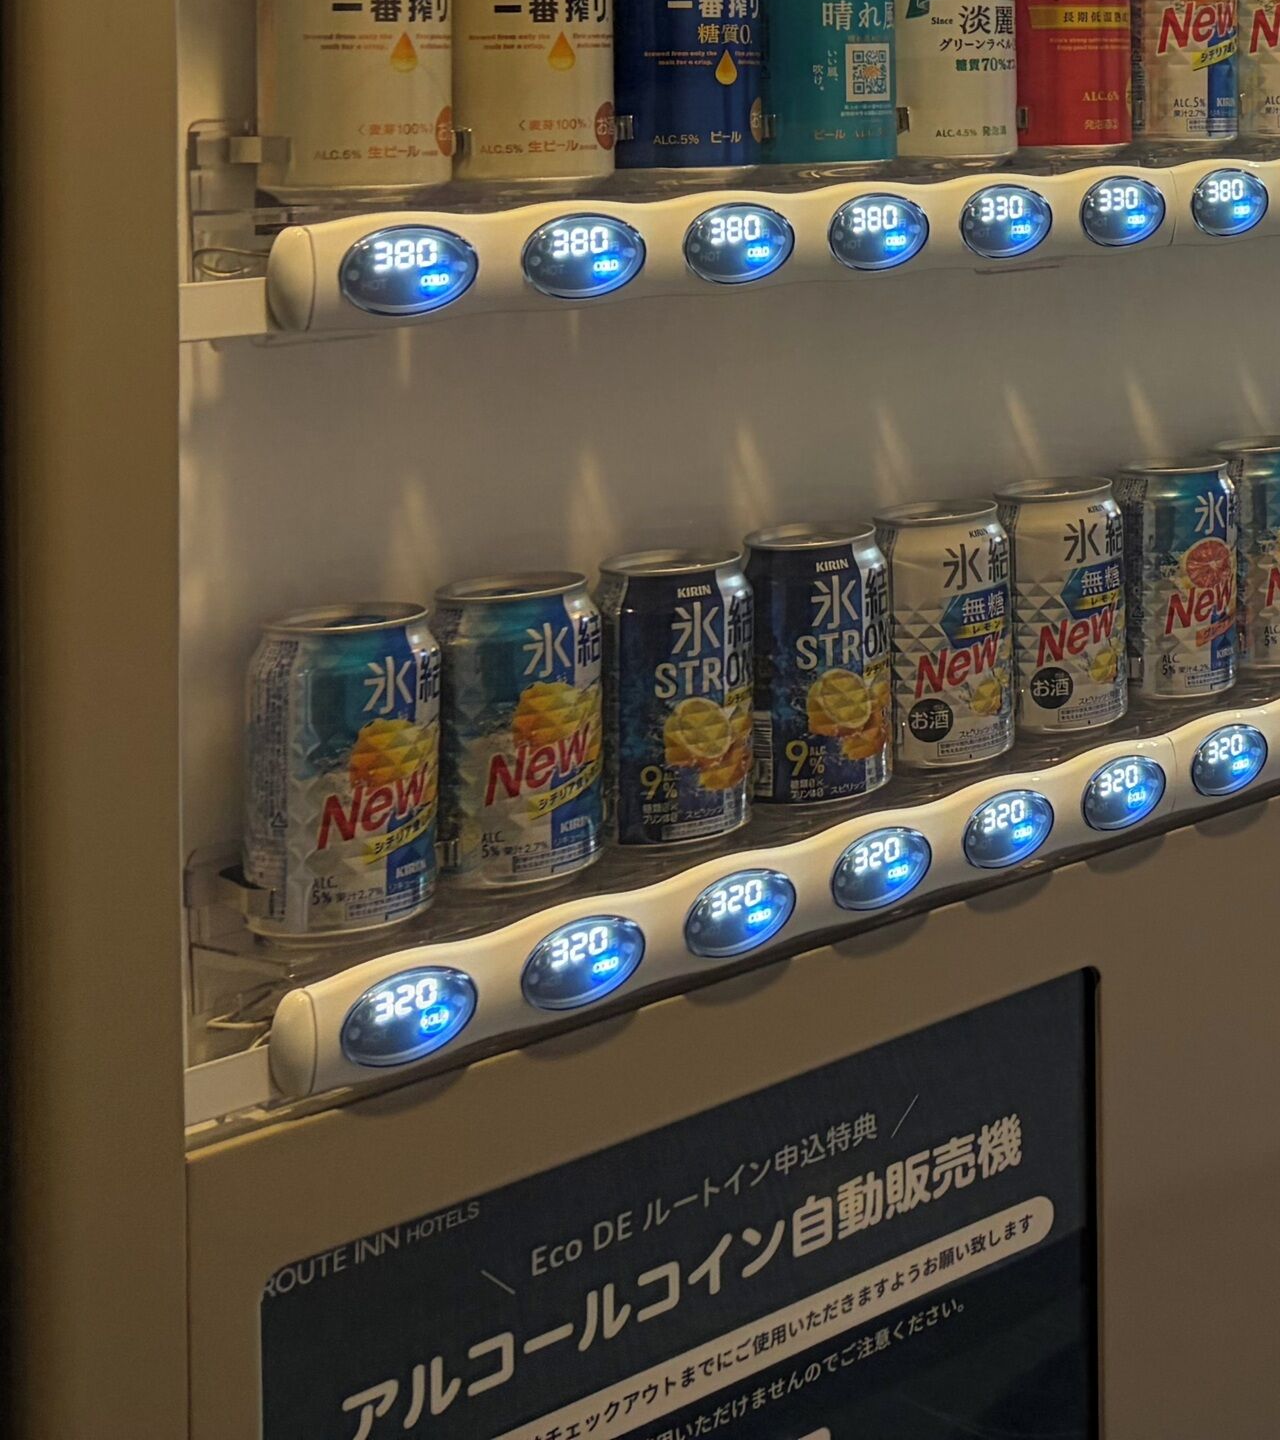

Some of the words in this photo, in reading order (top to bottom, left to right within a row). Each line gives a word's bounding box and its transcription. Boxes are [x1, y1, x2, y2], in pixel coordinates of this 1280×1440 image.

[960, 3, 1014, 35] 淡麗
[1157, 0, 1237, 56] New
[710, 131, 743, 145] ビール
[1100, 187, 1139, 212] 330
[1208, 178, 1244, 203] 380
[853, 205, 898, 234] 380
[980, 195, 1024, 223] 330
[553, 226, 609, 259] 380
[711, 215, 762, 245] 380
[374, 238, 438, 272] 380
[1063, 511, 1123, 564] 氷結
[815, 558, 850, 573] KIRIN
[943, 534, 1009, 591] 氷結
[677, 584, 712, 599] KIRIN
[1080, 564, 1120, 597] 無糖
[962, 591, 1005, 623] 無糖
[1165, 573, 1234, 636] New
[1036, 600, 1117, 668] New
[914, 628, 1000, 700] New
[1033, 680, 1070, 702] お酒
[911, 711, 950, 732] お酒
[484, 720, 592, 808] New
[1207, 732, 1243, 765] 320
[1099, 764, 1139, 798] 320
[316, 758, 430, 853] New
[983, 798, 1026, 835] 320
[853, 836, 901, 875] 320
[711, 878, 763, 919] 320
[550, 925, 610, 969] 320
[374, 976, 438, 1026] 320
[530, 1238, 585, 1278] Eco
[593, 1210, 634, 1252] DE
[643, 1111, 879, 1232] ルートイン申込特典
[262, 1247, 348, 1300] ROUTE
[354, 1225, 402, 1266] INN
[406, 1200, 481, 1246] HOTELS
[341, 1111, 1024, 1440] アルコールコイン自動販売機
